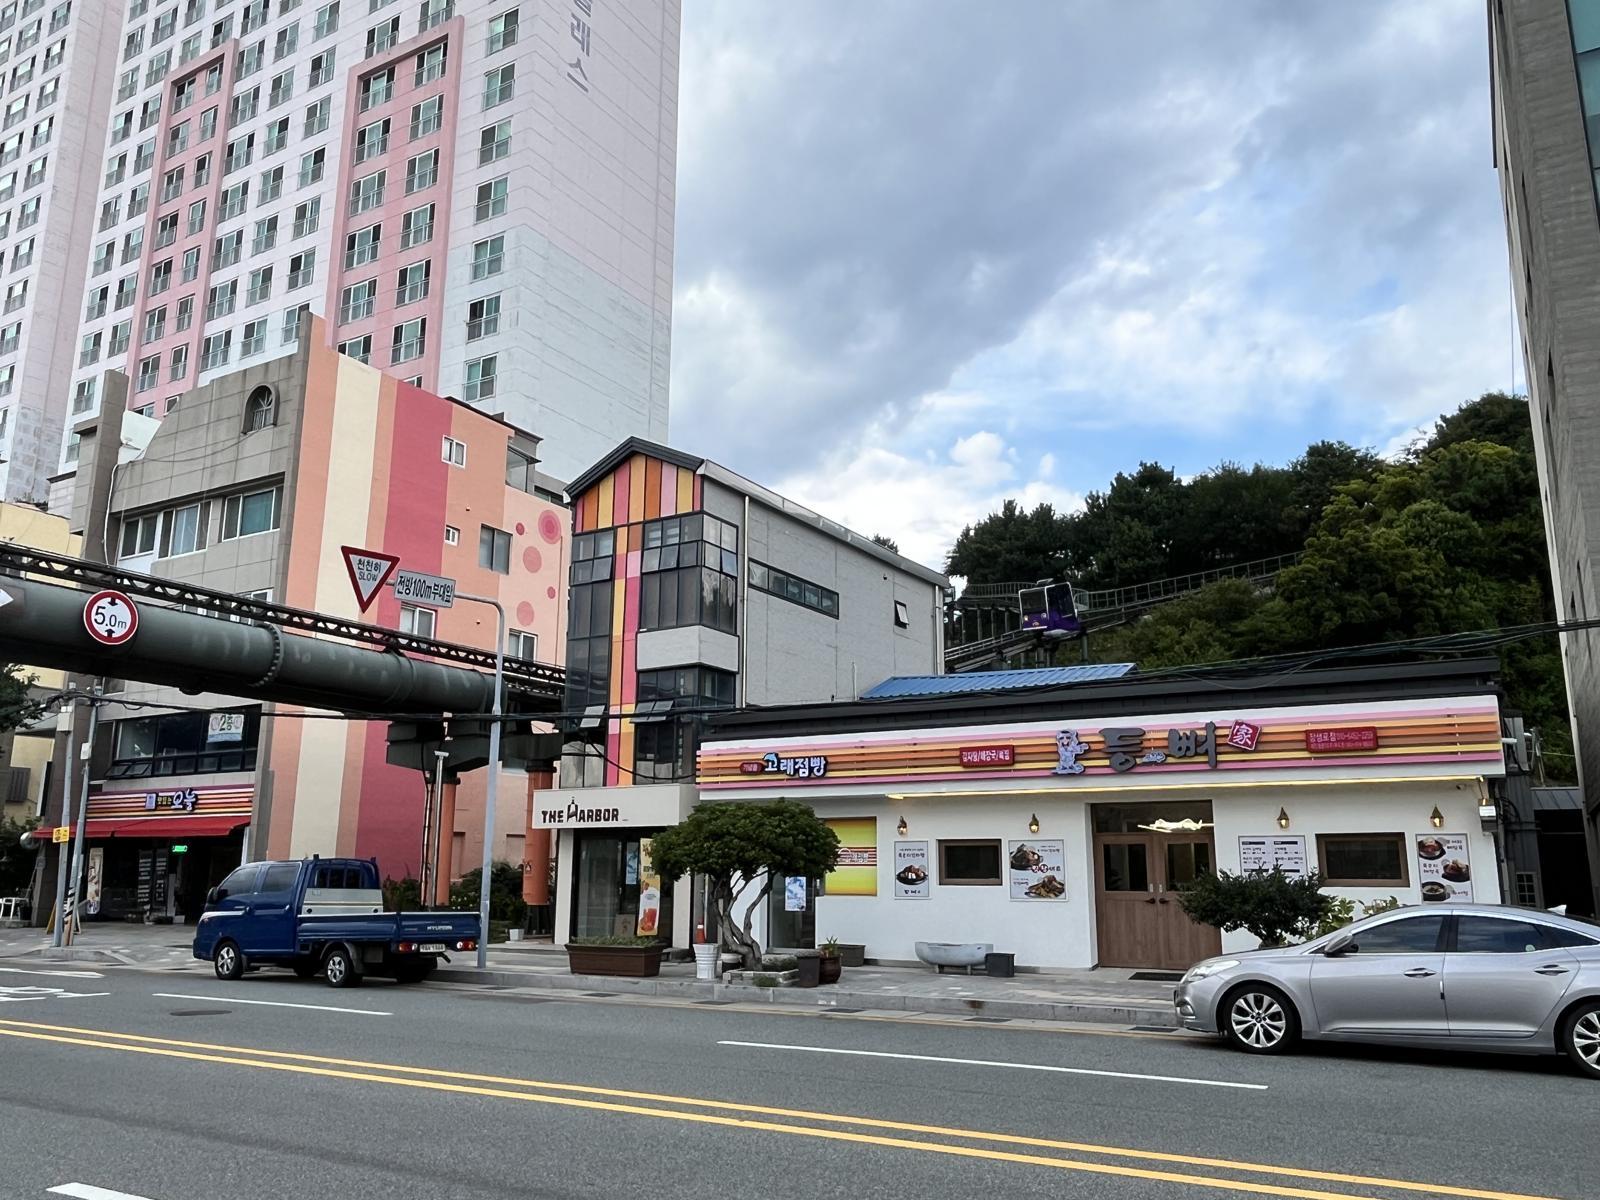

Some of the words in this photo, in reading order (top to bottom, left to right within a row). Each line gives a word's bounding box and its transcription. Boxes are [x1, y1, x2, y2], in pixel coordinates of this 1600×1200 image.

[358, 571, 379, 582] SLOW
[94, 605, 127, 629] 5.0m
[1232, 723, 1252, 748] 家
[764, 752, 826, 778] 고래점빵
[170, 788, 196, 811] 오늘
[541, 809, 564, 824] THE
[566, 800, 619, 823] HARBOR
